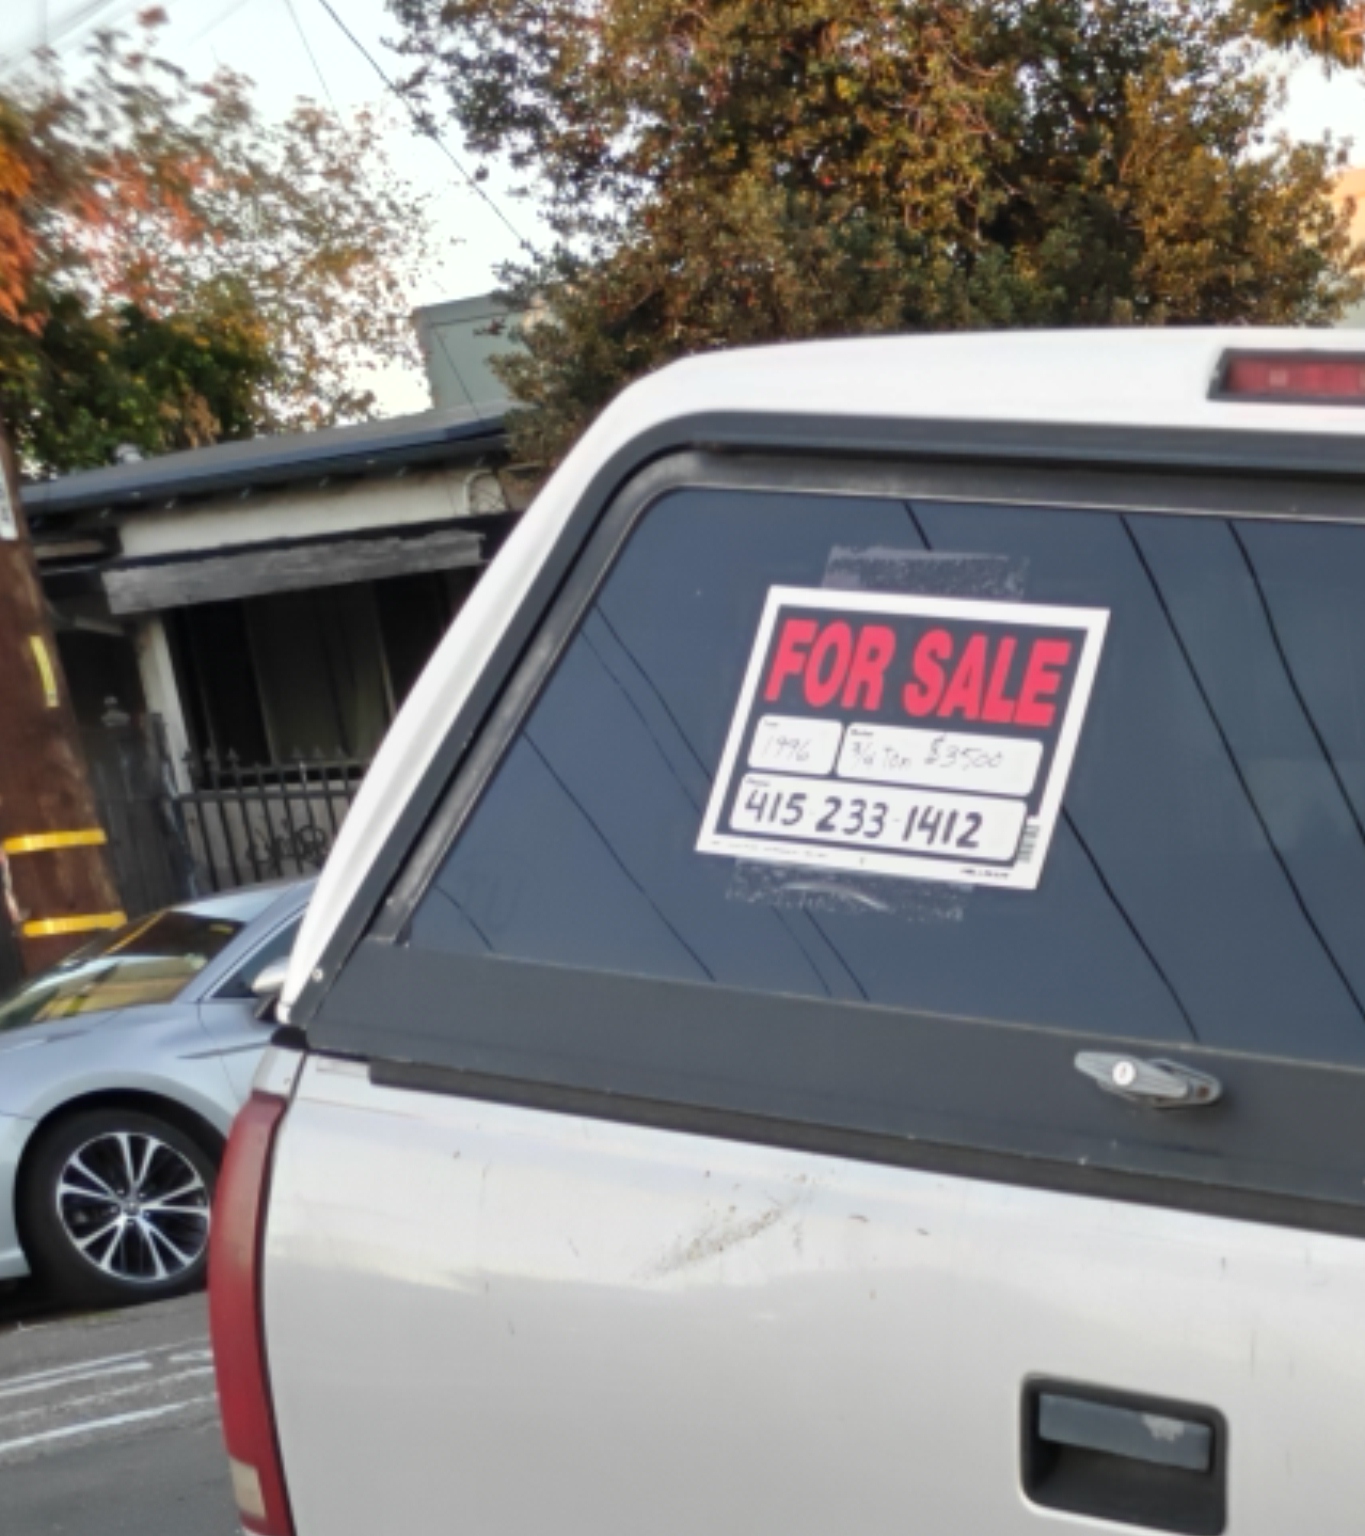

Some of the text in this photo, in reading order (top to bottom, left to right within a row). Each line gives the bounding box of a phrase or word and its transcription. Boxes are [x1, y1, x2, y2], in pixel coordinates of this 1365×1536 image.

[764, 617, 1073, 728] FOR SALE
[744, 788, 984, 849] 415 233 1412
